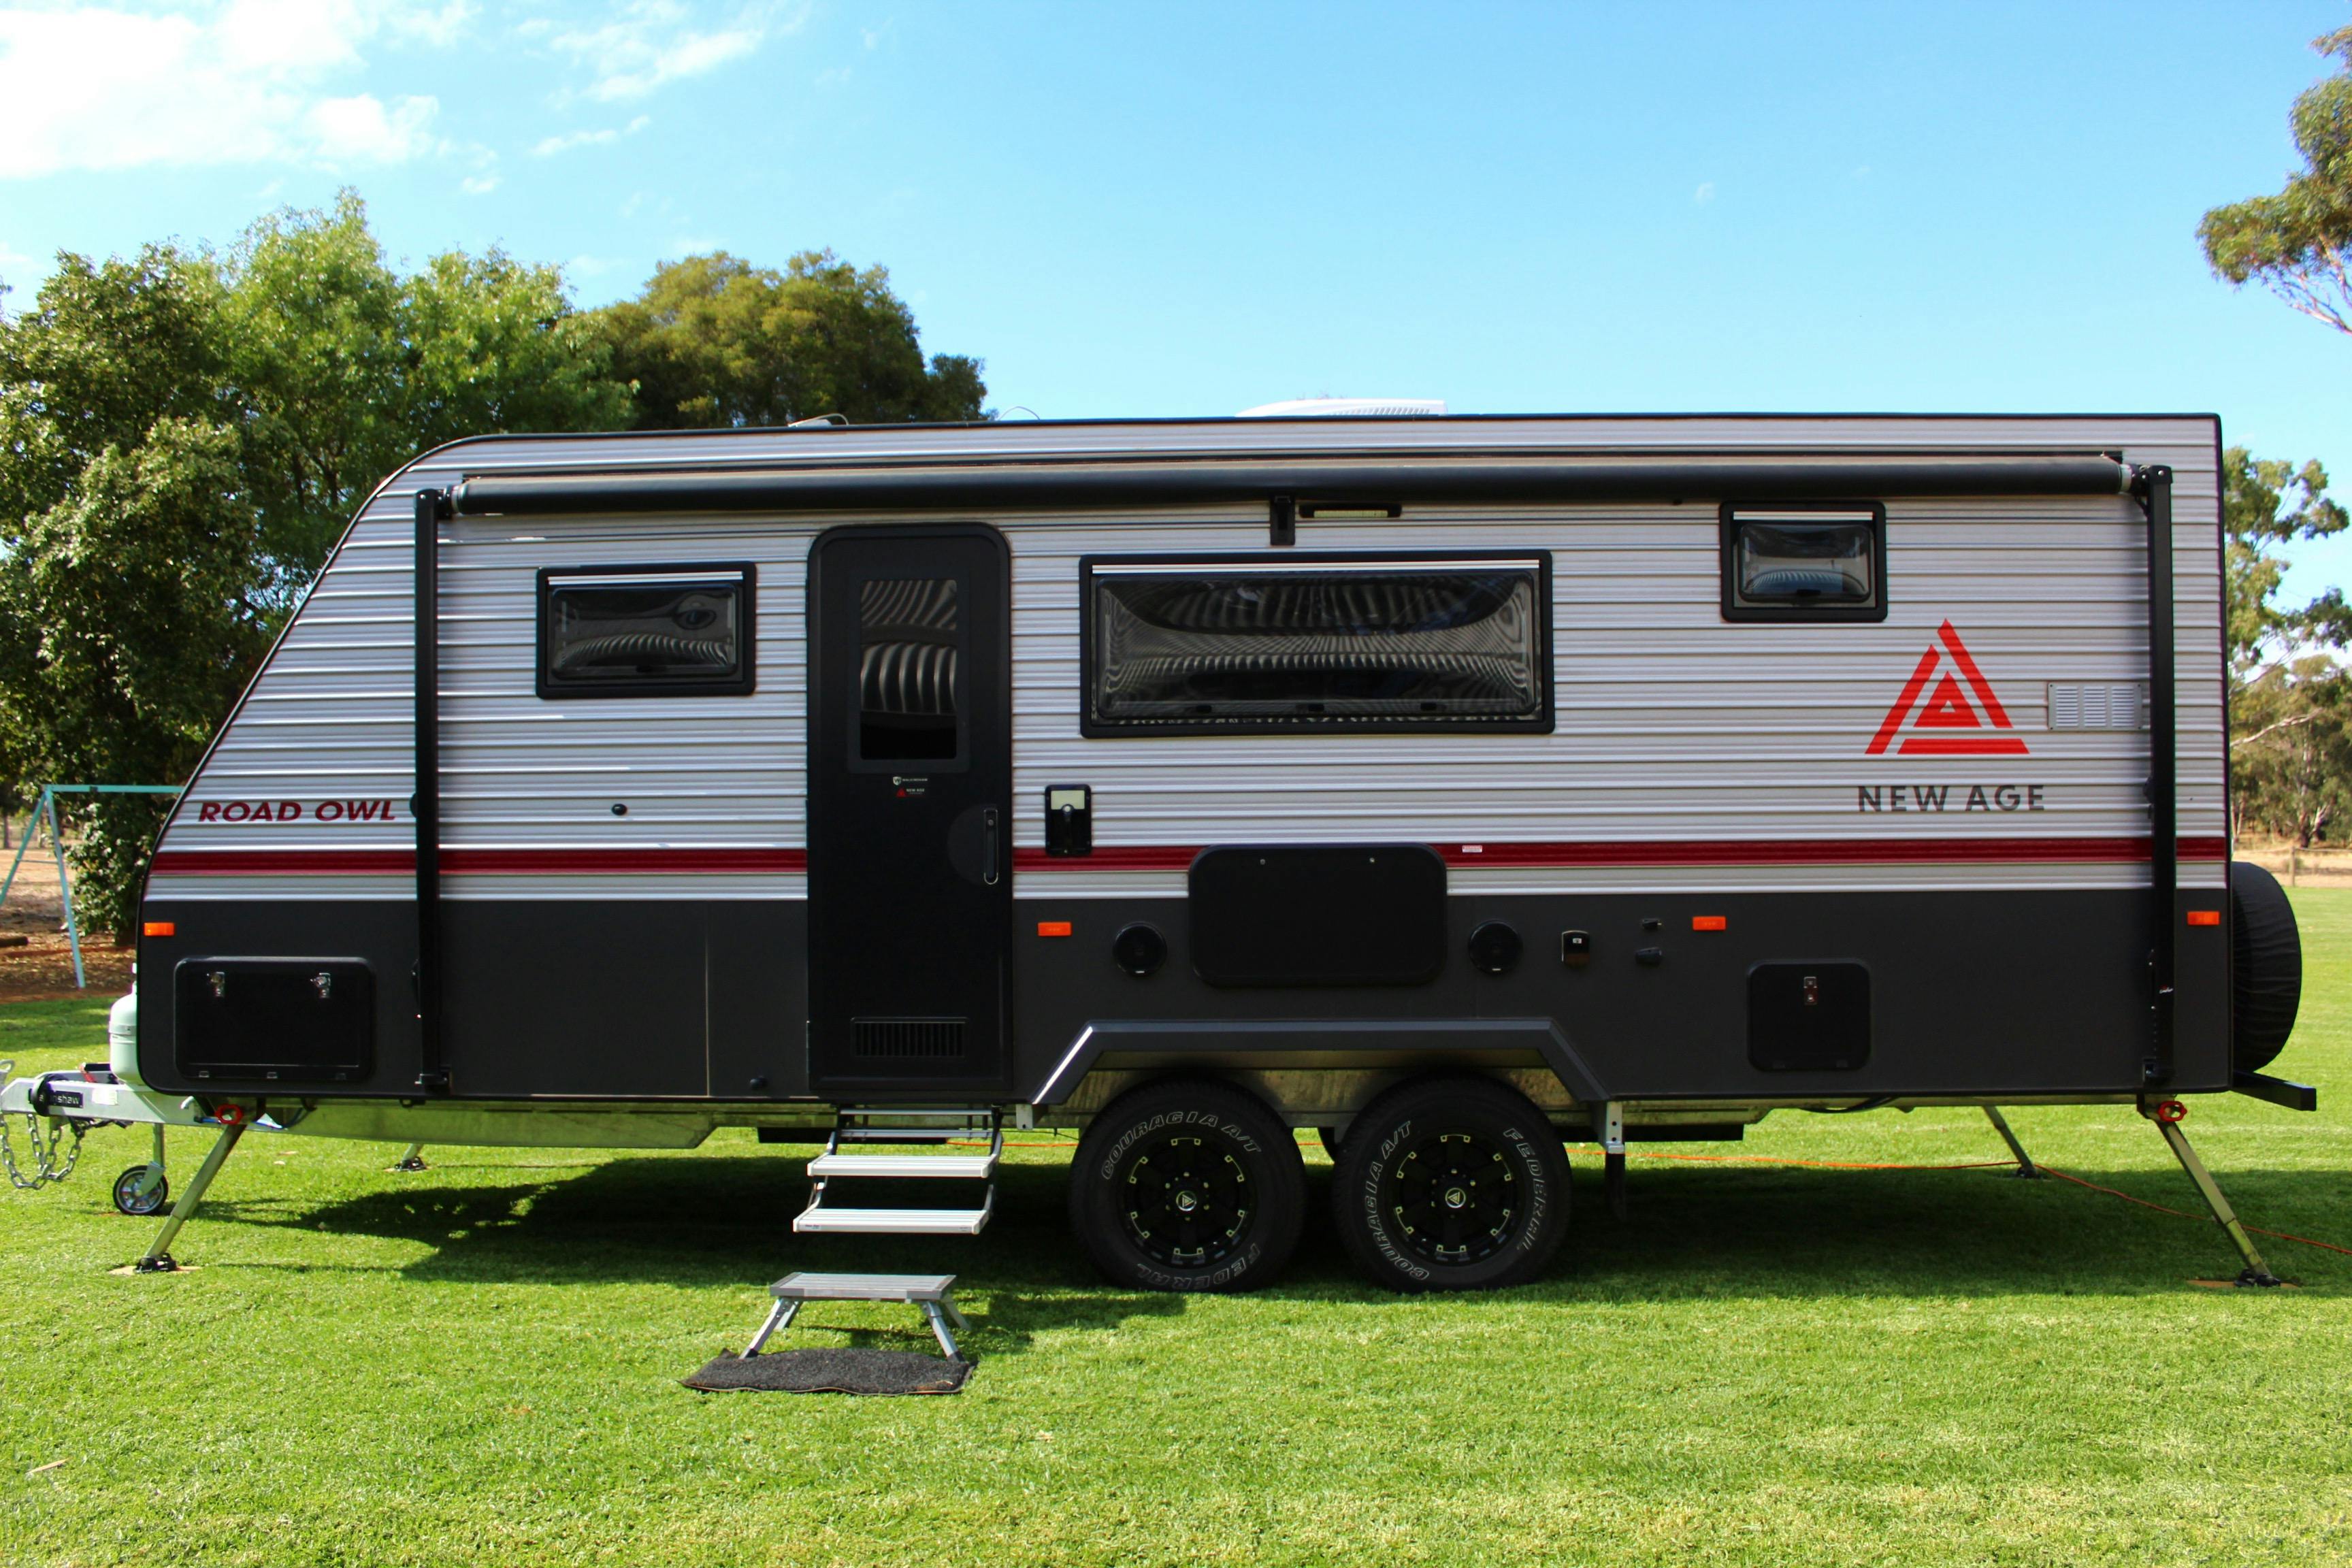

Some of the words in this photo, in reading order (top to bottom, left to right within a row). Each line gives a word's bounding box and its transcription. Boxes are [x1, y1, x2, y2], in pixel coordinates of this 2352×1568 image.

[1858, 786, 1948, 812] NEW
[1965, 785, 2044, 811] AGE
[199, 801, 301, 822] ROAD
[315, 800, 396, 820] OWL
